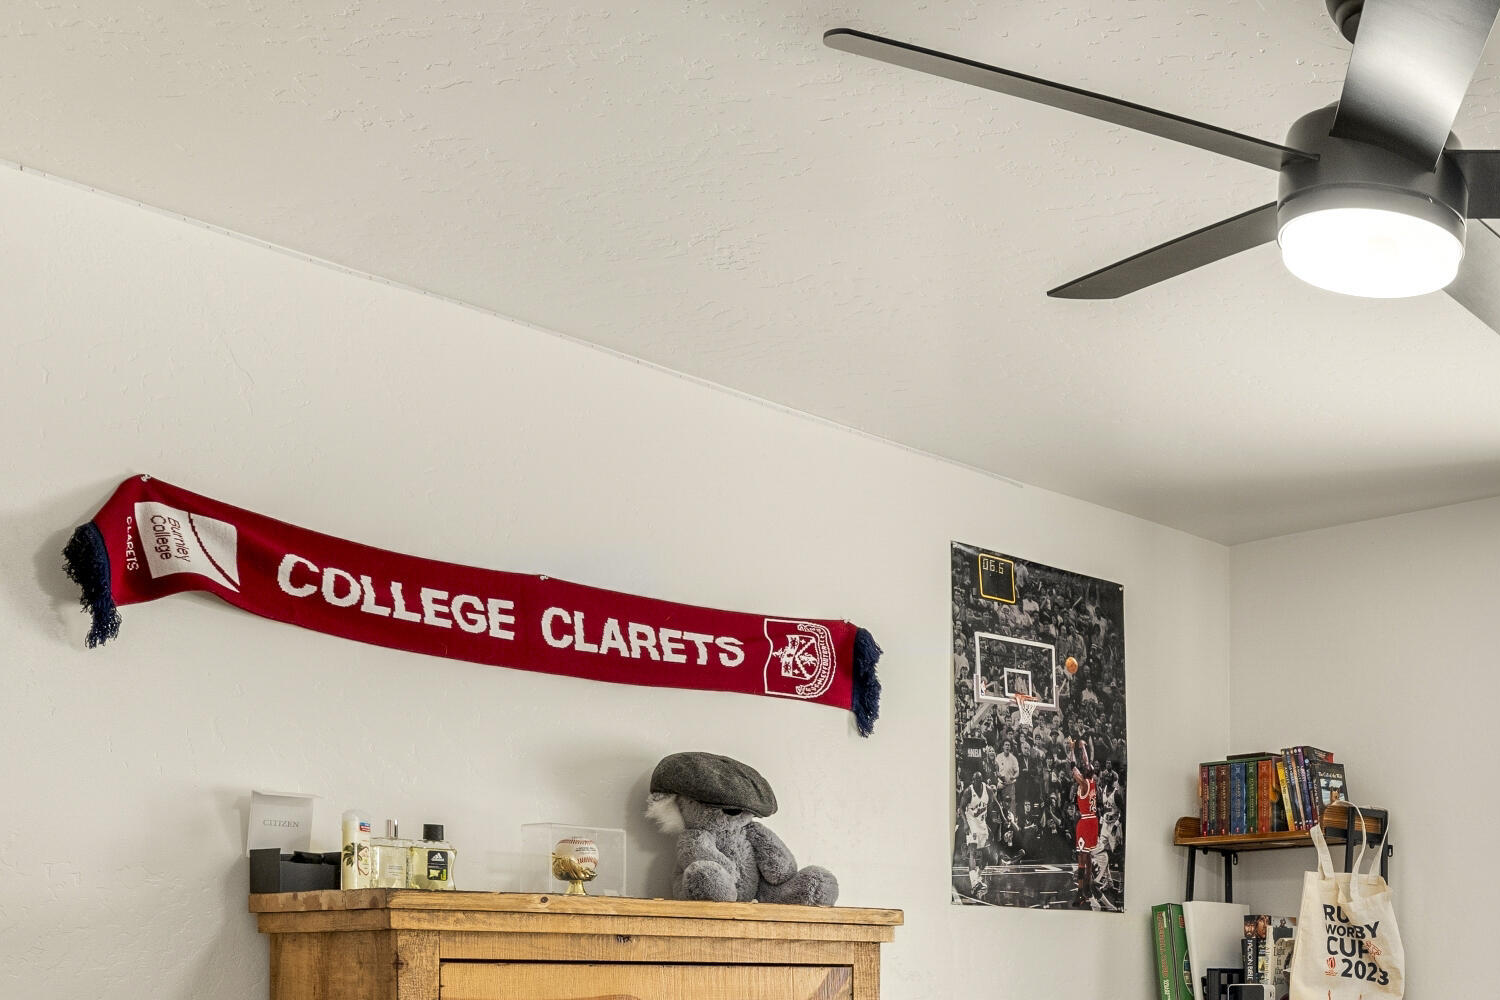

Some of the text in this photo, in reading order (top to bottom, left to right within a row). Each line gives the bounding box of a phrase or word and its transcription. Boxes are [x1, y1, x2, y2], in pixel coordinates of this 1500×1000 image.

[125, 516, 139, 571] CLARETS
[150, 515, 172, 560] College
[167, 516, 190, 562] Burnley
[277, 553, 745, 667] COLLEGE CLARETS
[263, 820, 299, 828] CITIZEN
[1341, 958, 1389, 986] 2023
